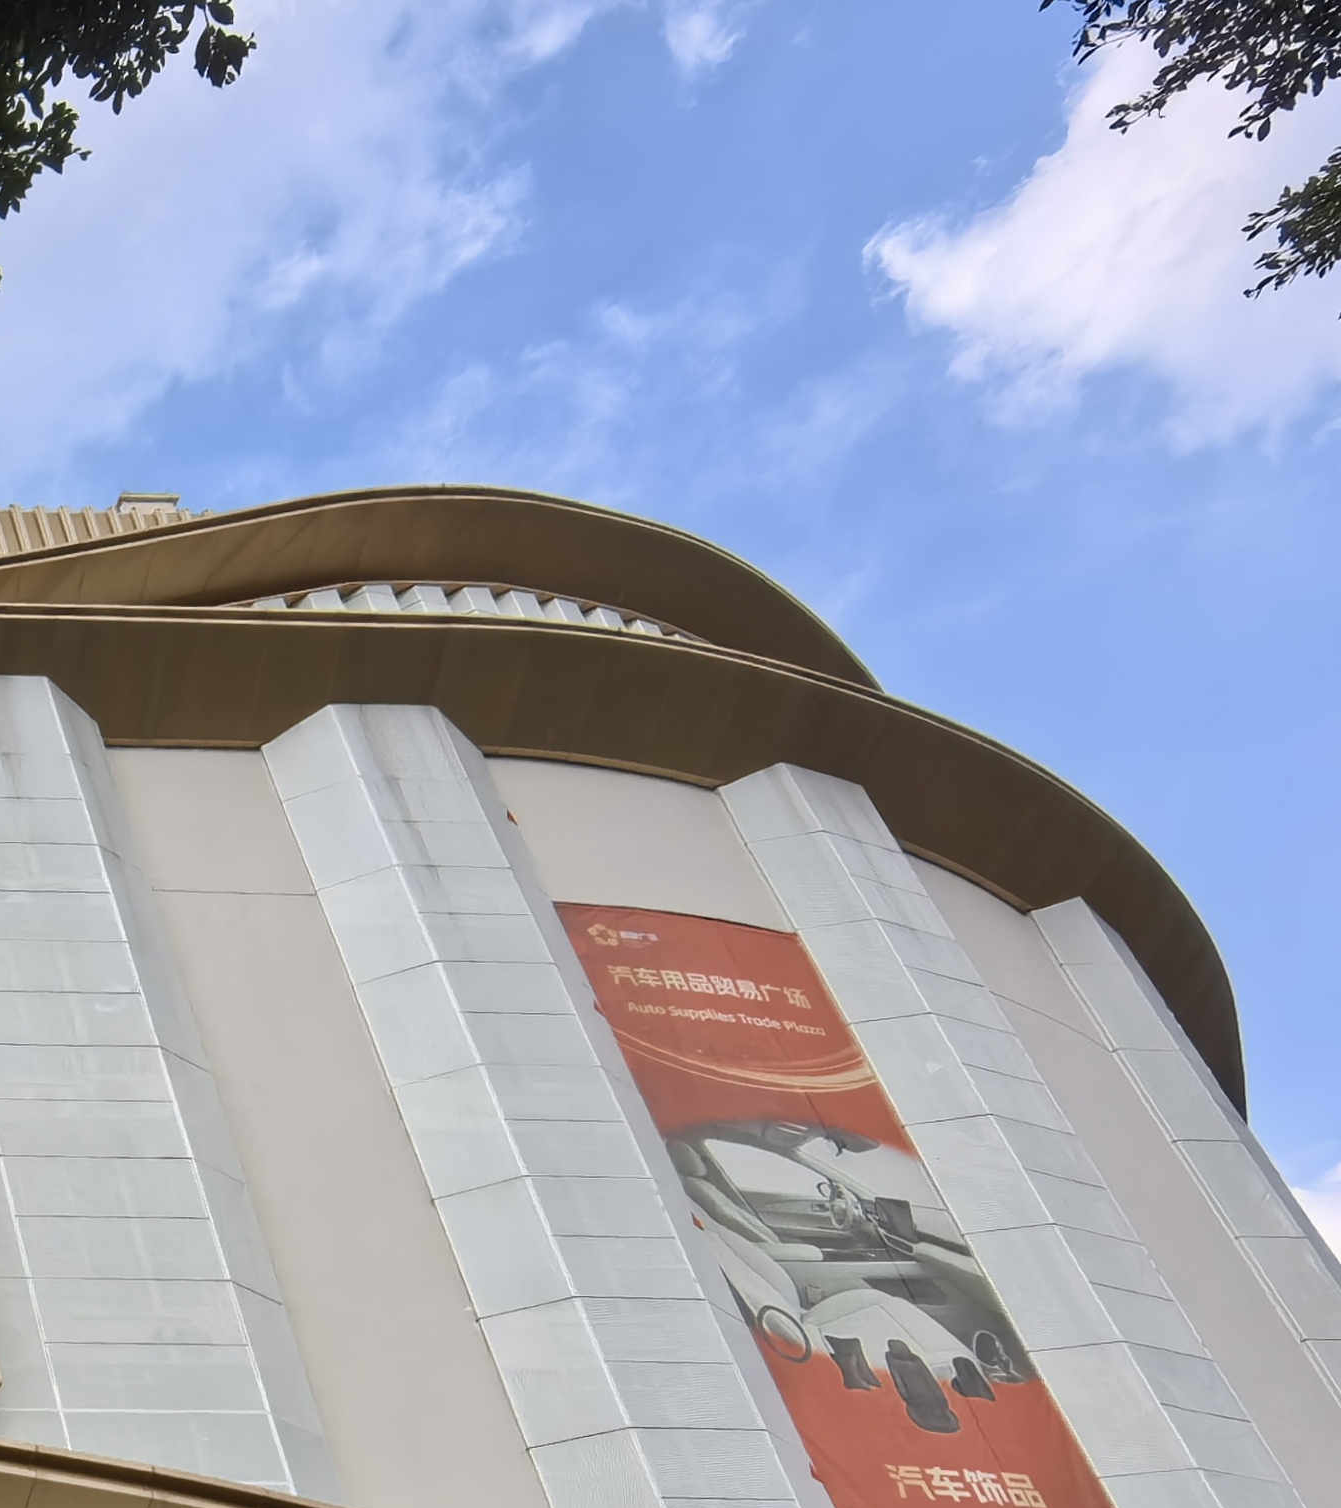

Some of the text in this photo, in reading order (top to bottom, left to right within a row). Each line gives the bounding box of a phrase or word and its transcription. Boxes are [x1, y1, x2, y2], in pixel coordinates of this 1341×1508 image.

[628, 1001, 826, 1037] Auto Supplies Trade Plaza
[884, 1464, 1048, 1508] 汽车饰品
